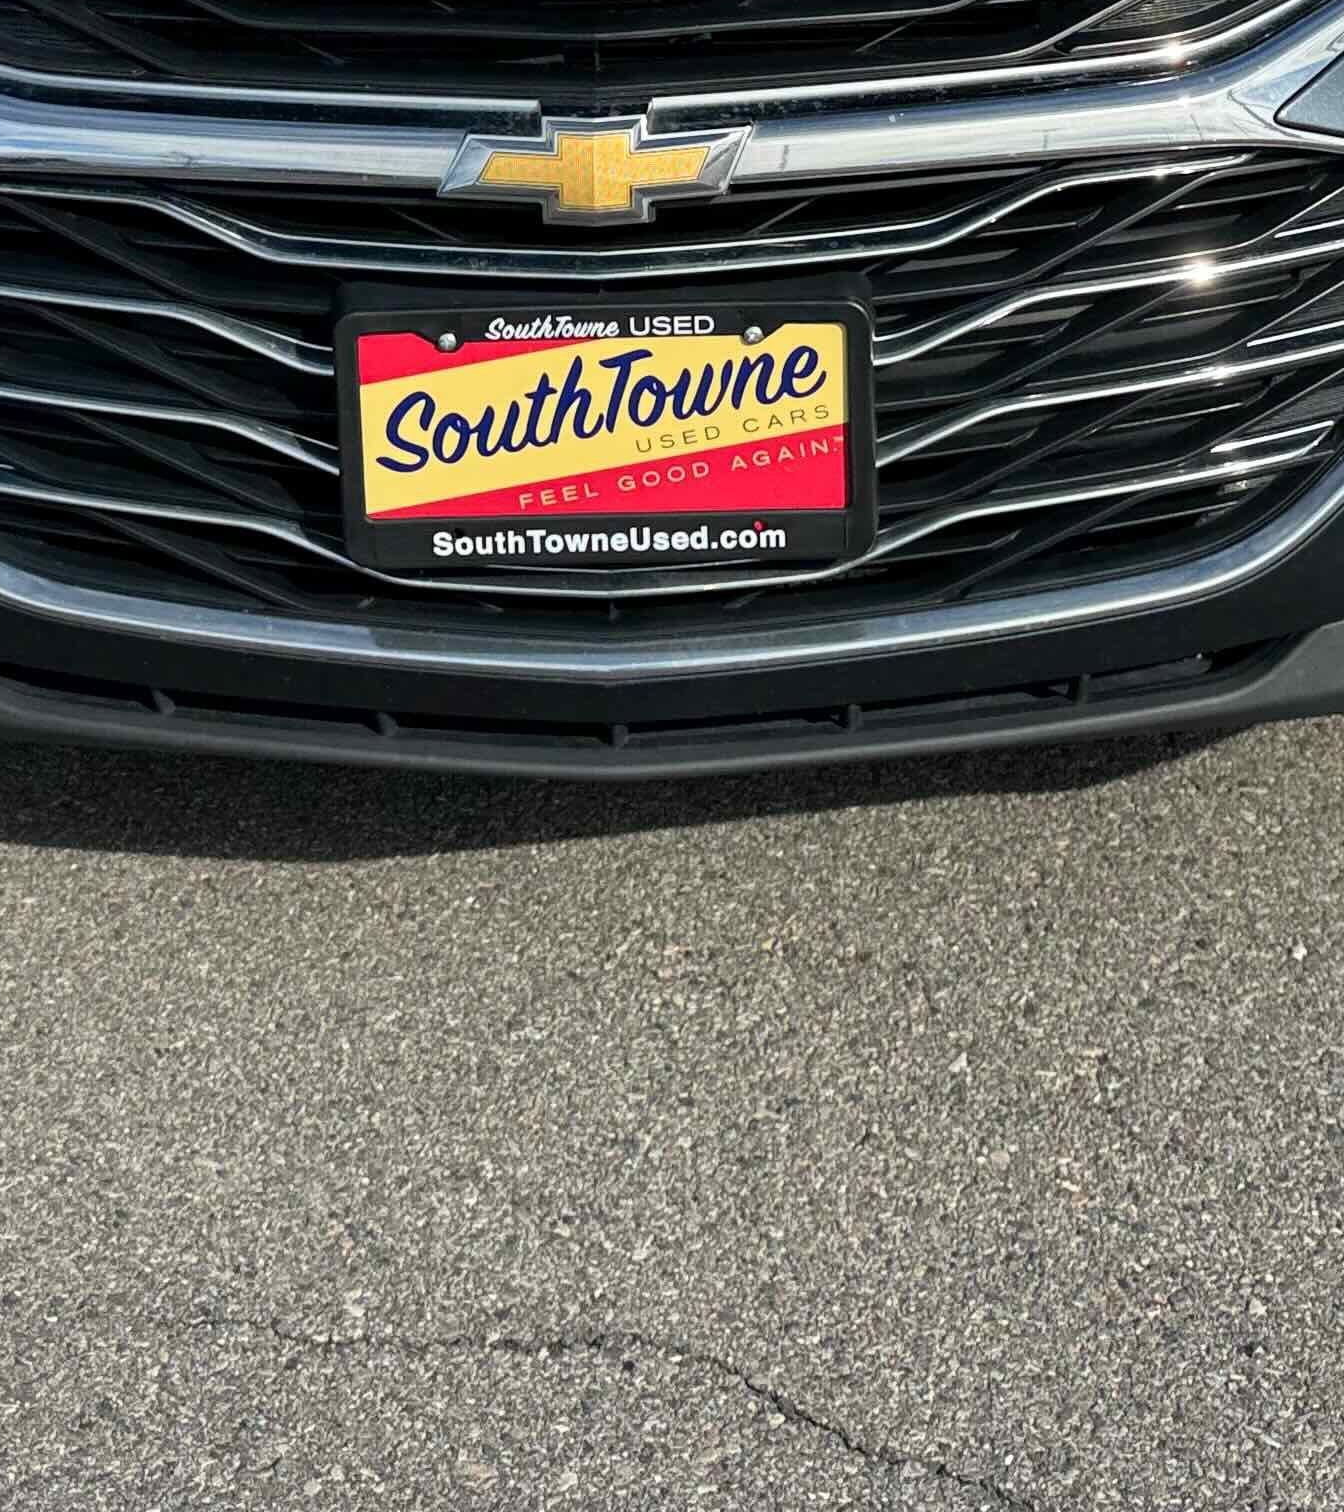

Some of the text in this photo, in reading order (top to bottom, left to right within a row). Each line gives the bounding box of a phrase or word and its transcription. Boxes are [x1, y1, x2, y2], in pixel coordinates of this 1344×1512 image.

[484, 315, 715, 340] SouthTowne USED
[375, 344, 827, 473] SouthTowne
[636, 404, 830, 454] USED CARS
[519, 483, 599, 510] FEEL
[617, 462, 710, 493] GOOD
[432, 525, 787, 557] SouthTowneUsed.com
